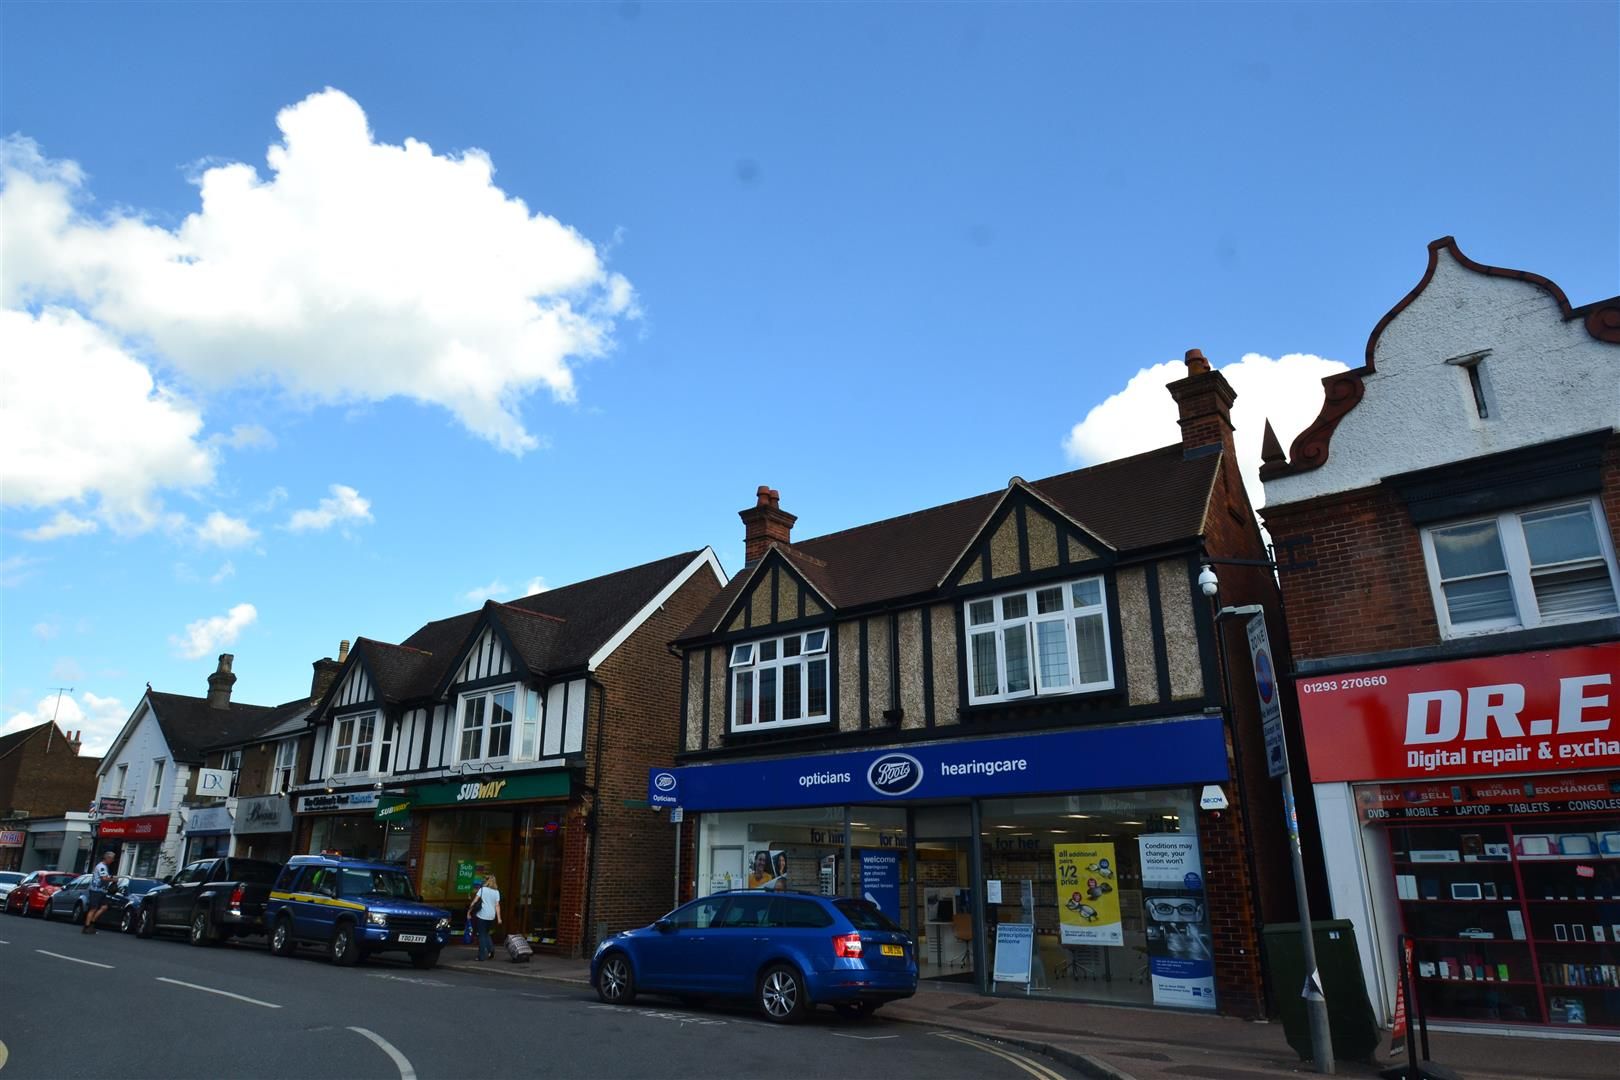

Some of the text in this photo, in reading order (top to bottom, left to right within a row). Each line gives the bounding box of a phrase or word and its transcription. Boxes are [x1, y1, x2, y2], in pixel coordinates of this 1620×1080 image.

[1250, 630, 1265, 650] ZONE
[1303, 675, 1388, 694] 01293 270660
[1404, 673, 1612, 745] DR.E
[1407, 747, 1466, 771] Digital
[1473, 743, 1531, 767] repair
[1538, 741, 1553, 760] &
[875, 761, 911, 785] Boots
[941, 757, 1027, 776] hearingcare
[203, 773, 224, 790] DR
[799, 771, 851, 788] opticians
[457, 780, 505, 801] SUBWAY
[1421, 792, 1449, 800] SELL
[1476, 788, 1521, 798] REPAIR
[1535, 783, 1606, 795] EXCHANGE
[653, 794, 677, 803] Opticians
[1378, 793, 1400, 801] BUY
[379, 802, 409, 817] SUBWAY
[1368, 799, 1620, 819] DVDs MOBILE LAPTOP TABLETS CONSOLES
[811, 828, 825, 843] for
[995, 836, 1014, 849] for
[1146, 850, 1169, 858] change,
[1179, 843, 1192, 851] may
[864, 855, 896, 863] welcome
[1059, 864, 1078, 878] 1/2
[1061, 878, 1078, 886] price
